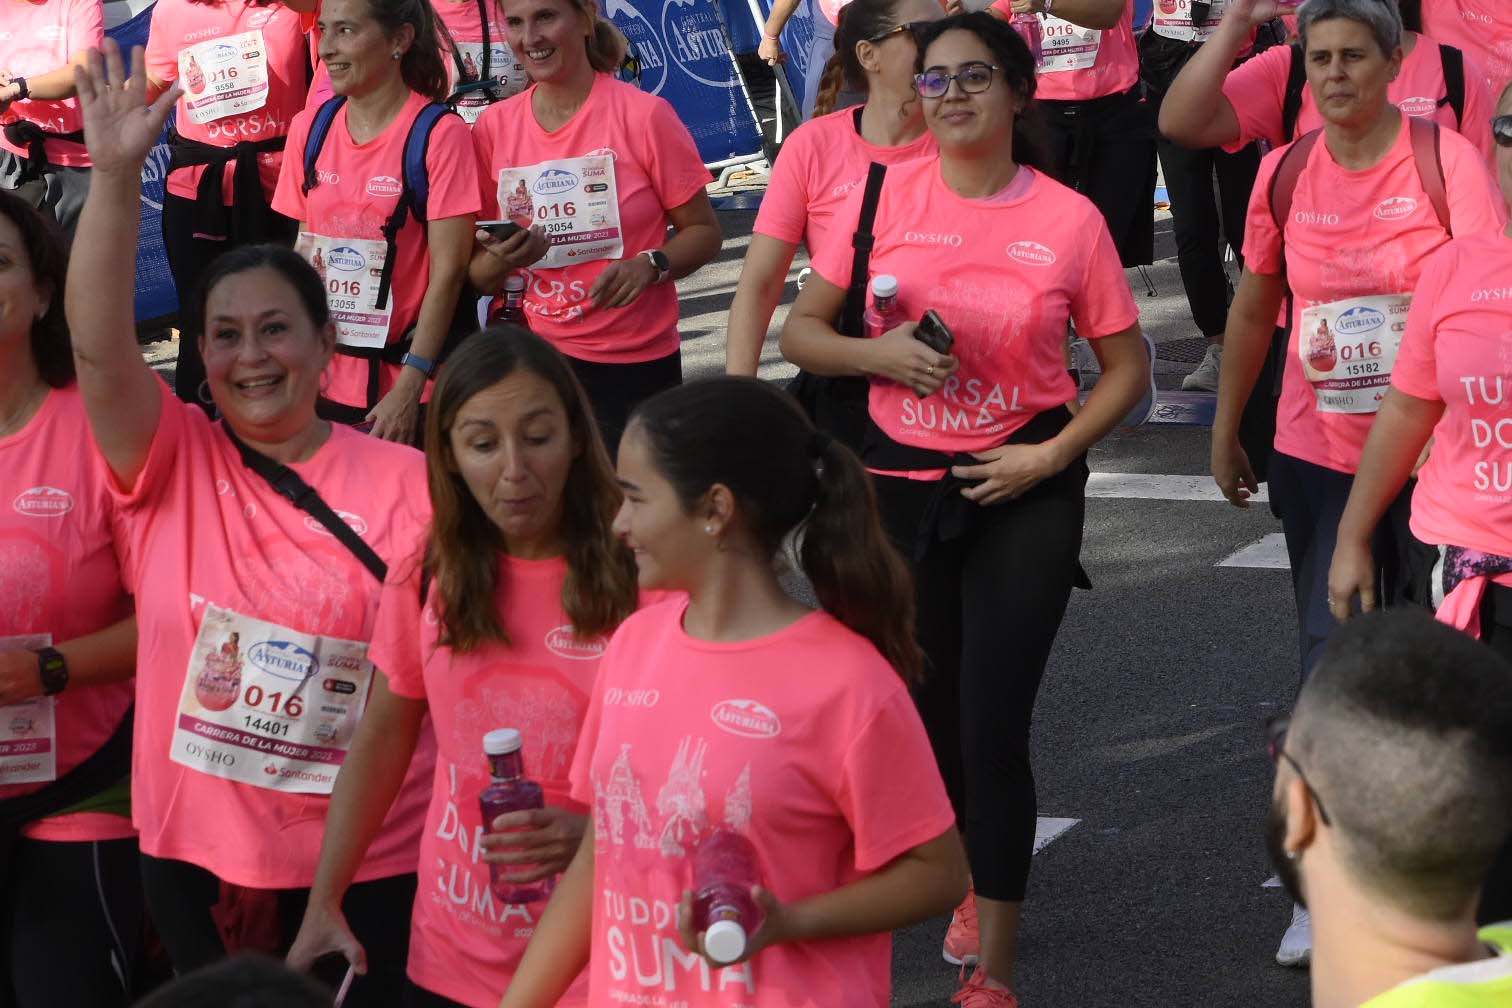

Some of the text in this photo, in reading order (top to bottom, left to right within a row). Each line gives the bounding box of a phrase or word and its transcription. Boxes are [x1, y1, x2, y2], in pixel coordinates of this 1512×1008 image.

[1047, 24, 1073, 36] 016
[1052, 38, 1069, 46] 9495
[538, 201, 576, 219] 016
[1295, 211, 1340, 225] OYSHO
[904, 231, 962, 248] OYSHO
[329, 279, 361, 295] 016
[330, 299, 356, 310] 13055
[1337, 316, 1382, 330] ASTURIANA
[1340, 342, 1382, 360] 016
[1346, 362, 1379, 375] 15182
[1351, 379, 1360, 388] DE
[1361, 378, 1372, 386] LA
[1459, 376, 1504, 405] TU
[943, 378, 1024, 411] RSAL
[901, 398, 996, 432] SUMA
[326, 660, 361, 672] SUMA
[244, 684, 305, 718] 016
[244, 714, 290, 736] 14401
[194, 721, 241, 743] CARRERA
[240, 733, 256, 747] DE
[258, 736, 272, 750] LA
[273, 740, 308, 759] MUJER
[185, 740, 236, 768] OYSHO
[278, 766, 332, 784] Santander
[603, 890, 626, 922] TU
[607, 924, 756, 994] SUMA
